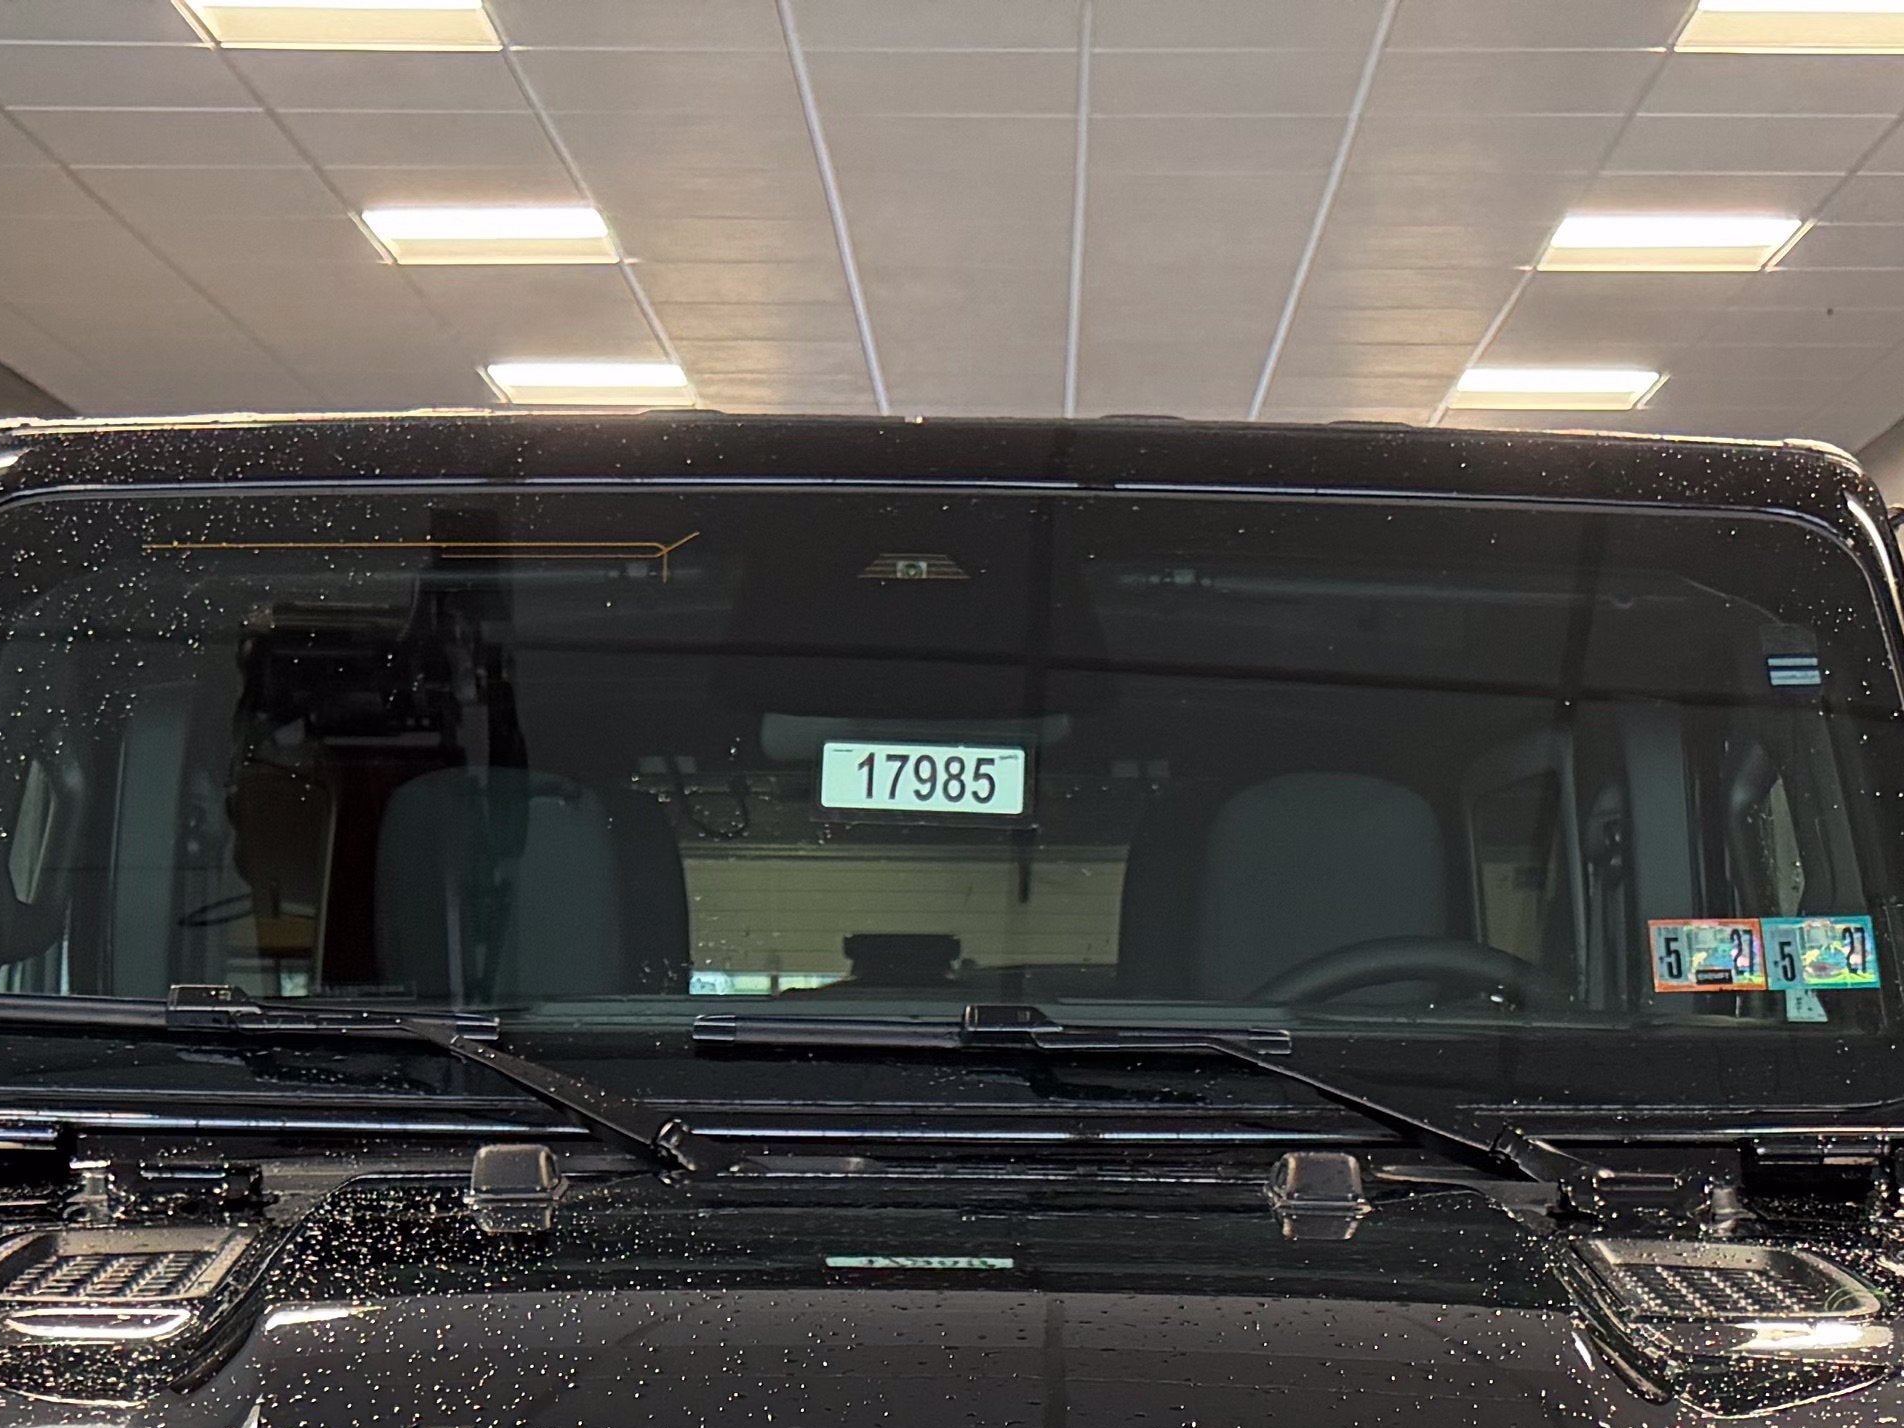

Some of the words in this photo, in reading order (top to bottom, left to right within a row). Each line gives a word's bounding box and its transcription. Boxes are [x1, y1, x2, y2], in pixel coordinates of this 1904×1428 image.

[857, 751, 996, 804] 17985
[1663, 937, 1683, 979] 5
[1778, 941, 1797, 982] 5
